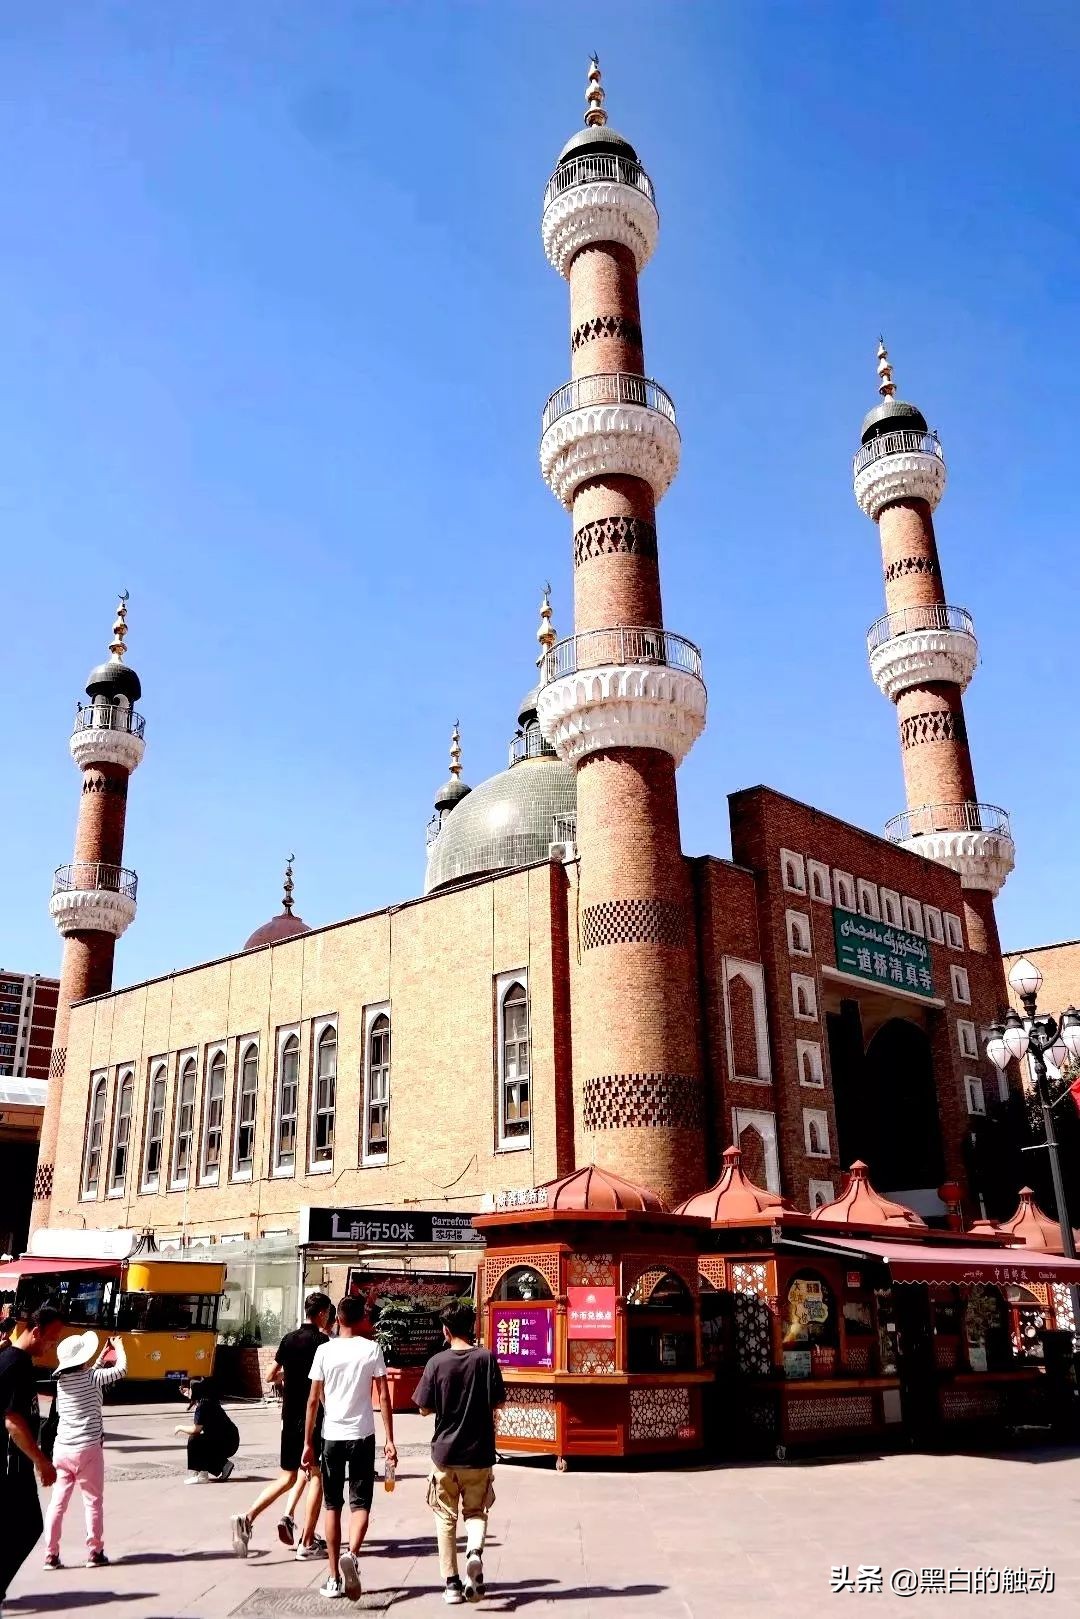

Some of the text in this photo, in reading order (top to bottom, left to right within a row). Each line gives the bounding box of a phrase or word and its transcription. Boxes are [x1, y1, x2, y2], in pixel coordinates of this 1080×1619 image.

[350, 1221, 415, 1241] 前行50米
[435, 1229, 463, 1240] 家乐福
